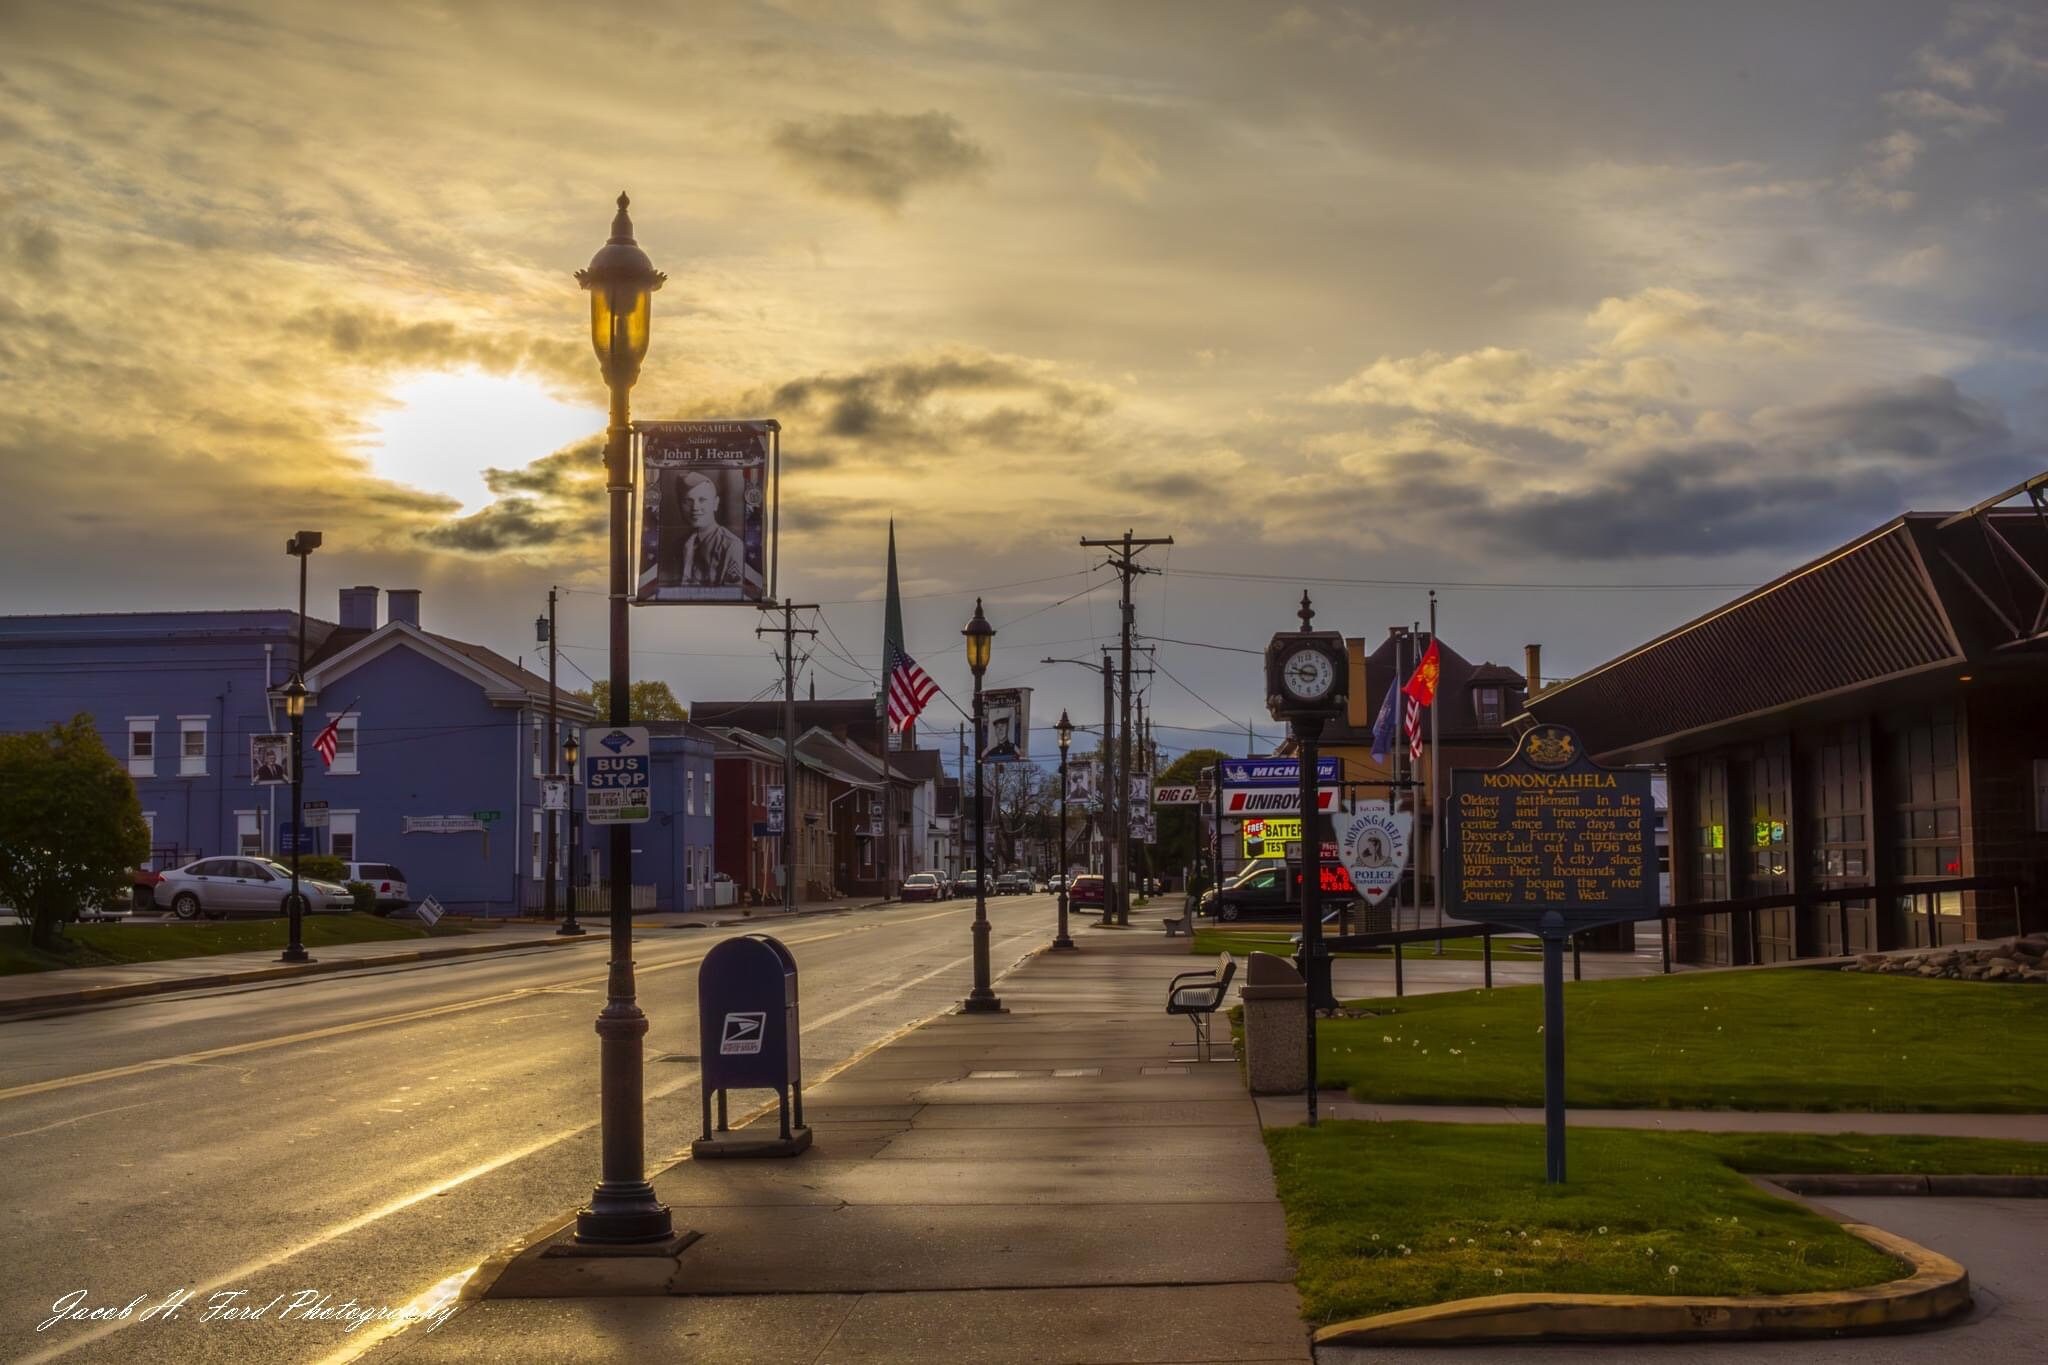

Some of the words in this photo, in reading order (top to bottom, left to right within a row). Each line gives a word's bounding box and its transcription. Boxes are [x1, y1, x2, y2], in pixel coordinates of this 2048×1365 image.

[660, 424, 742, 433] MONONGAHELA
[664, 449, 692, 459] John
[694, 449, 702, 461] J.
[706, 449, 744, 458] Hearn
[597, 758, 638, 770] BUS
[592, 773, 645, 786] STOP
[1483, 774, 1617, 788] MONONGAHELA
[1158, 789, 1180, 801] BIG
[1460, 794, 1500, 806] Oldest
[1515, 795, 1580, 806] settlement
[1596, 794, 1609, 806] in
[1622, 794, 1640, 806] the
[1461, 807, 1498, 819] valley
[1516, 807, 1538, 817] and
[1552, 807, 1641, 819] transportation
[1247, 821, 1264, 833] FREE
[1344, 814, 1402, 848] MONONGAHELA
[1460, 820, 1499, 830] center
[1512, 819, 1543, 830] since
[1556, 819, 1576, 829] the
[1587, 819, 1616, 831] days
[1628, 819, 1641, 829] of
[1461, 830, 1515, 841] Devore's
[1579, 830, 1641, 841] chartered
[1506, 842, 1533, 852] Laid
[1544, 842, 1564, 852] out
[1574, 842, 1584, 852] in
[1592, 842, 1620, 853] 1796
[1628, 844, 1642, 853] as
[1553, 854, 1564, 864] A
[1570, 854, 1595, 866] city
[1610, 854, 1642, 864] since
[1354, 870, 1396, 880] POLICE
[1510, 866, 1540, 876] Here
[1553, 866, 1616, 876] thousands
[1629, 866, 1642, 876] of
[1462, 878, 1514, 890] pioneers
[1526, 878, 1564, 890] began
[1577, 878, 1598, 888] the
[1612, 878, 1642, 888] river
[1462, 890, 1512, 902] journey
[1524, 890, 1537, 900] to
[1546, 890, 1566, 900] the
[1578, 890, 1608, 900] West.
